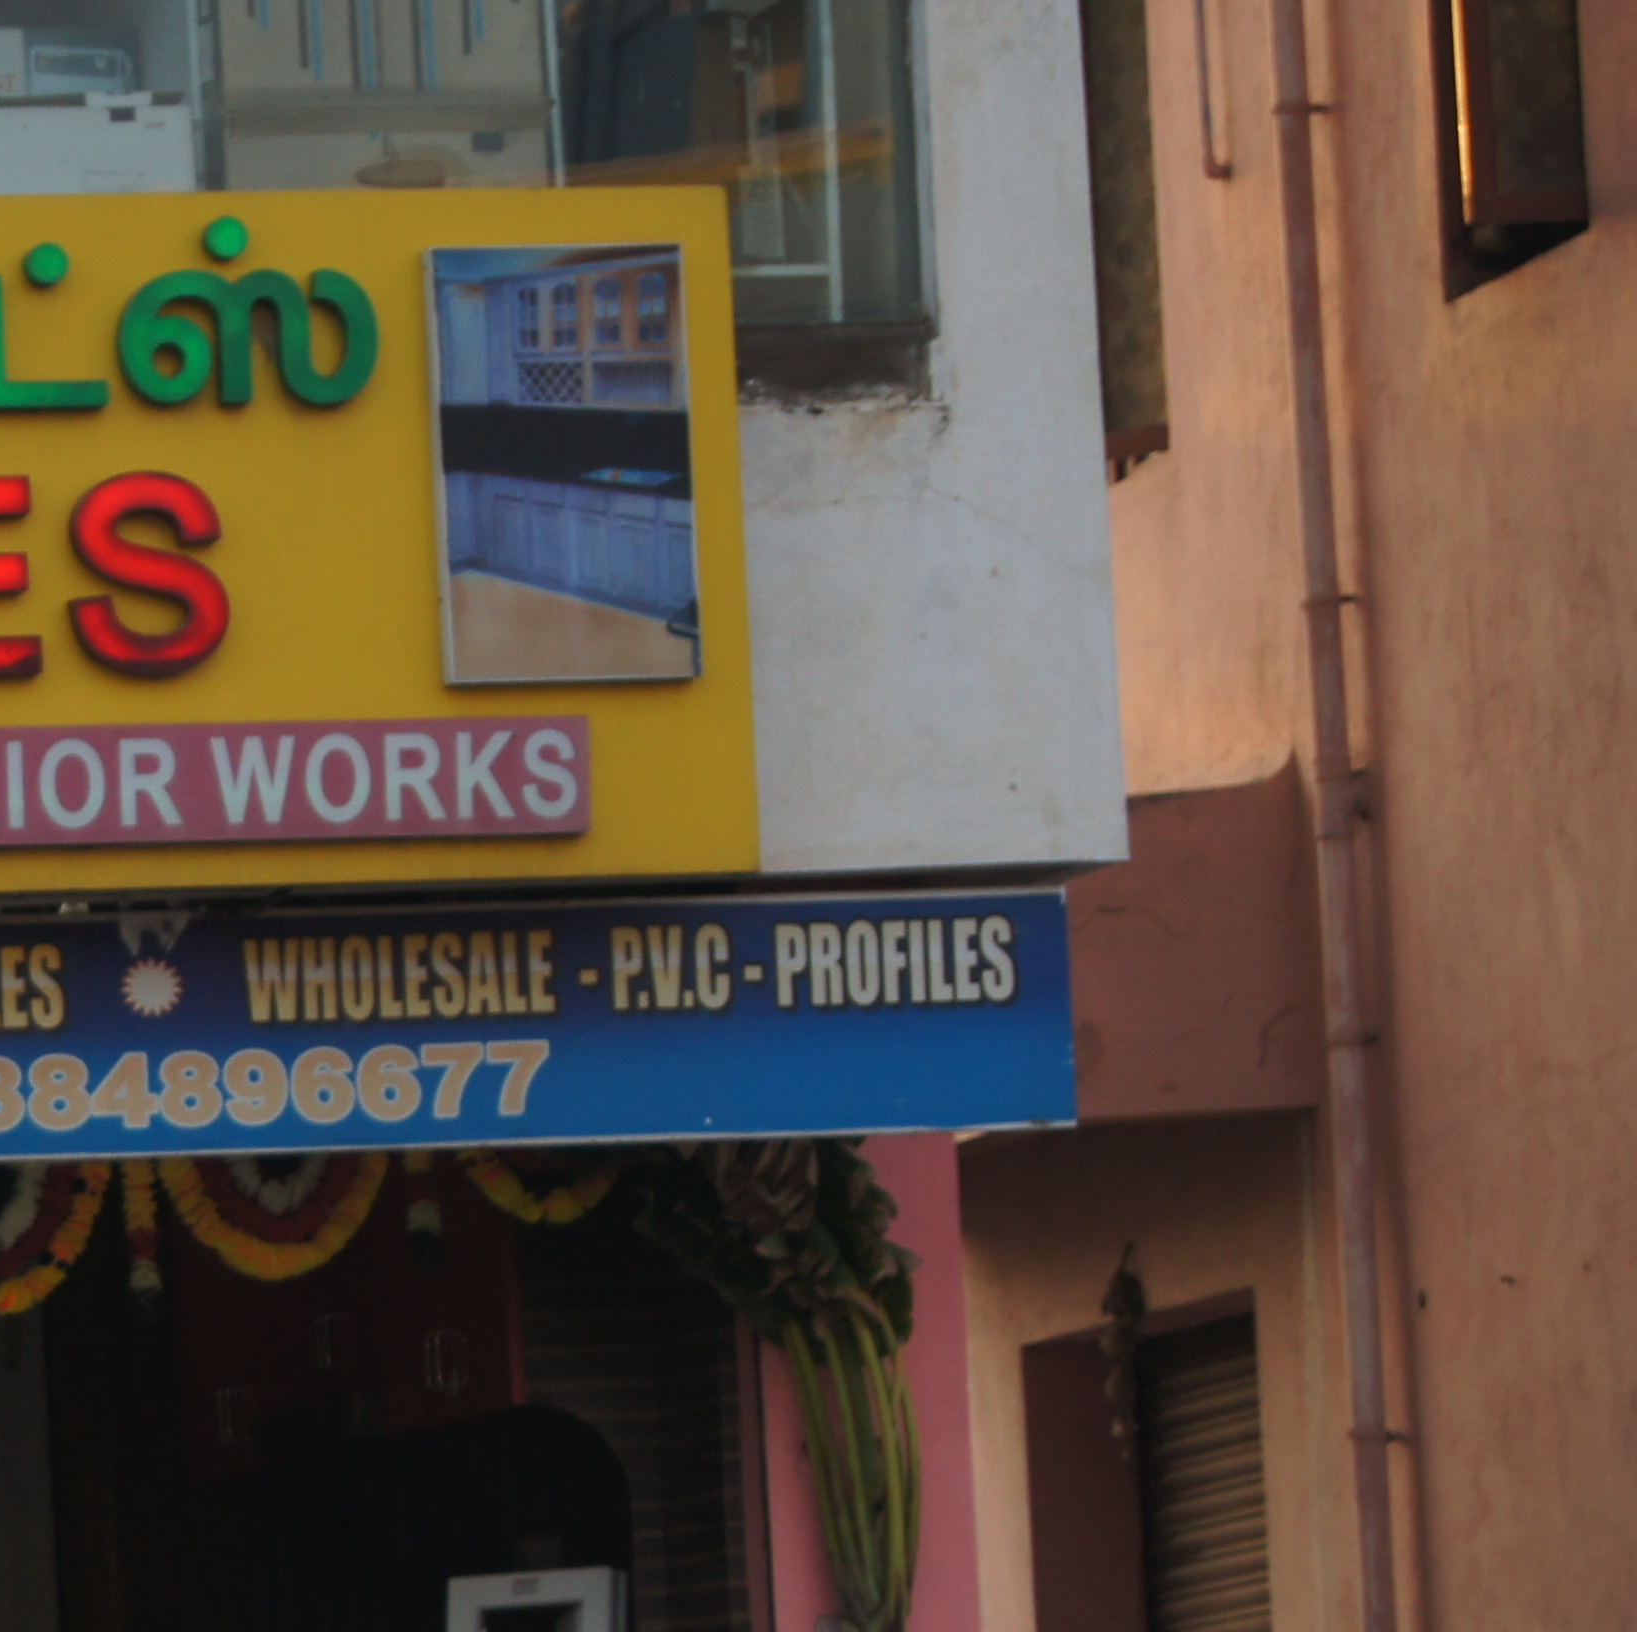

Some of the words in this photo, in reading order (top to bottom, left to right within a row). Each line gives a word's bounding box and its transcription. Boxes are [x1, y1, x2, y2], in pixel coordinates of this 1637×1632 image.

[209, 727, 580, 828] WORKS
[242, 929, 557, 1026] WHOLESALE
[610, 920, 731, 1014] P.V.C
[775, 914, 1016, 1008] PROFILES
